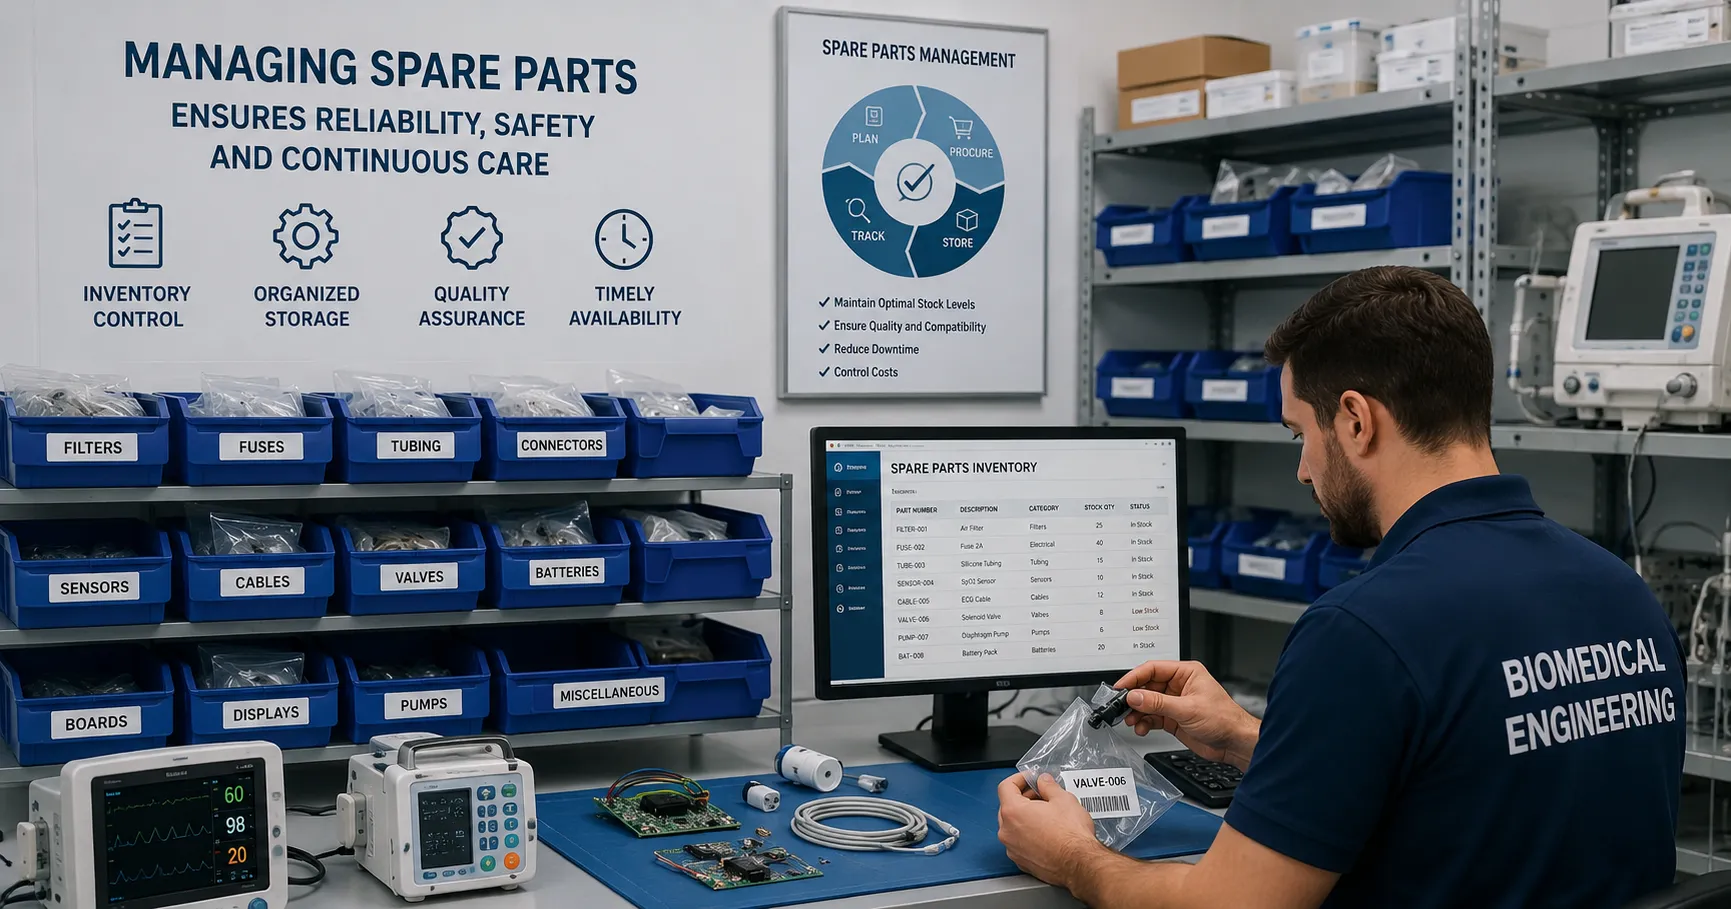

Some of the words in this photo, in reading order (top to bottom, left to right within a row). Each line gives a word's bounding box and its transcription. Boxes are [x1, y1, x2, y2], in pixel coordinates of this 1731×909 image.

[823, 39, 867, 57] SPARE
[872, 43, 915, 61] PARTS
[920, 47, 1015, 68] MANAGEMENT
[126, 41, 356, 85] MANAGING
[371, 50, 500, 89] SPARE
[515, 56, 637, 94] PARTS
[173, 103, 305, 130] ENSURES
[317, 107, 485, 139] RELIABILITY,
[495, 113, 595, 138] SAFETY
[853, 133, 878, 143] PLAN
[950, 147, 993, 158] PROCURE
[210, 145, 272, 169] AND
[282, 146, 468, 174] CONTINUOUS
[478, 151, 549, 175] CARE
[851, 231, 885, 240] TRACK
[943, 238, 973, 247] STORE
[84, 286, 190, 301] INVENTORY
[255, 286, 359, 301] ORGANIZED
[435, 286, 509, 302] QUALITY
[595, 287, 654, 301] TIMELY
[835, 297, 875, 307] Maintain
[879, 298, 915, 310] Optimal
[918, 299, 943, 308] Stock
[947, 299, 975, 309] Levels
[94, 311, 183, 327] CONTROL
[266, 311, 349, 326] STORAGE
[419, 311, 525, 326] ASSURANCE
[569, 311, 681, 325] AVAILABILITY
[835, 320, 866, 330] Ensure
[870, 321, 902, 333] Quality
[905, 322, 922, 331] and
[925, 322, 986, 334] Compatibility
[835, 344, 869, 353] Reduce
[872, 344, 919, 354] Downtime
[835, 367, 869, 377] Control
[872, 367, 898, 377] Costs
[65, 441, 122, 454] FILTERS
[240, 441, 284, 453] FUSES
[391, 440, 440, 452] TUBING
[522, 440, 602, 451] CONNECTORS
[891, 463, 929, 474] SPARE
[933, 463, 969, 473] PARTS
[973, 462, 1037, 473] INVENTORY
[396, 571, 443, 583] VALVES
[536, 566, 599, 578] BATTERIES
[61, 581, 129, 594] SENSORS
[236, 576, 289, 588] CABLES
[897, 579, 934, 587] SENSOR-004
[1138, 589, 1153, 597] Stock
[898, 598, 930, 606] CABLE-005
[899, 652, 924, 660] BAT-008
[1502, 638, 1668, 700] BIOMEDICAL
[559, 683, 661, 702] MISCELLANEOUS
[402, 698, 447, 711] PUMPS
[234, 706, 299, 721] DISPLAYS
[66, 715, 127, 730] BOARDS
[1506, 686, 1675, 755] ENGINEERING
[1074, 777, 1126, 788] VALVE-006
[225, 786, 243, 803] 60
[226, 816, 245, 833] 98
[228, 846, 246, 864] 20
